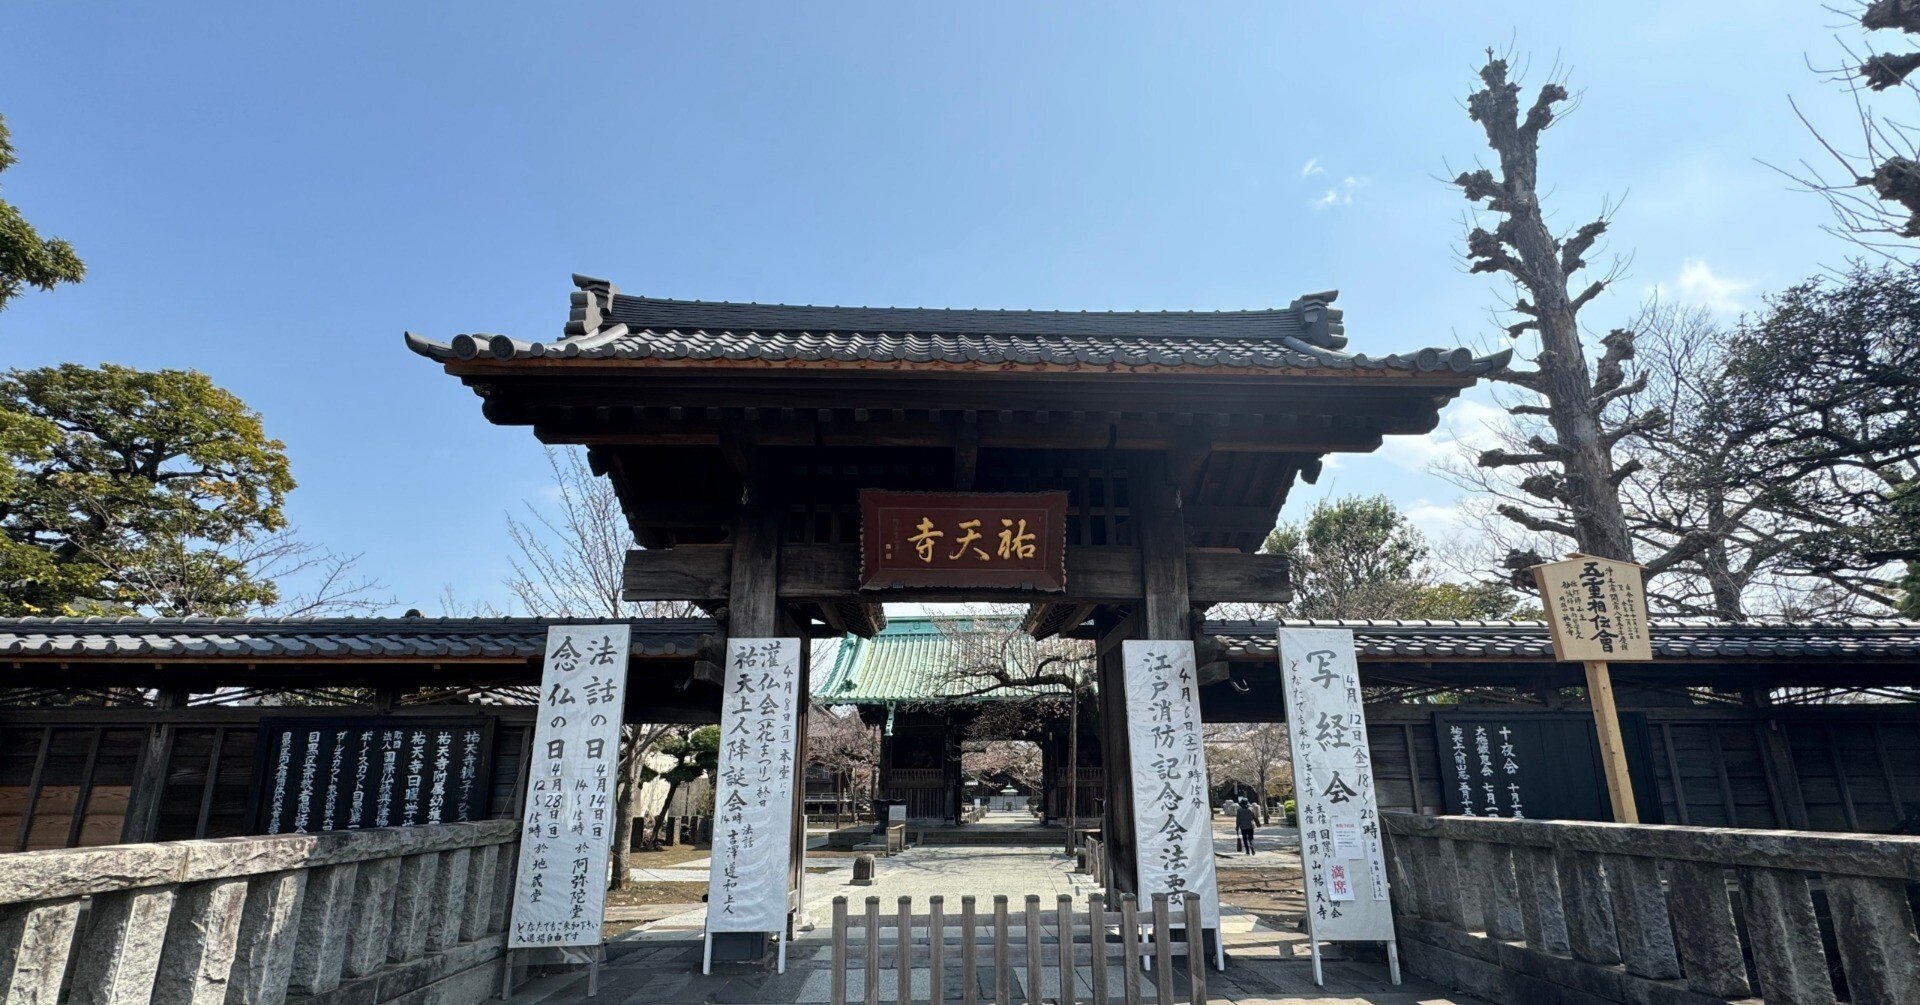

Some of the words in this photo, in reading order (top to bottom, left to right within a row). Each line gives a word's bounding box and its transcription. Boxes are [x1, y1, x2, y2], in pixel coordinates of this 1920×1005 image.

[546, 635, 582, 760] 念仏の日
[582, 635, 618, 760] 法話の日
[1305, 649, 1359, 804] 写経会
[1498, 726, 1520, 775] 十夜会
